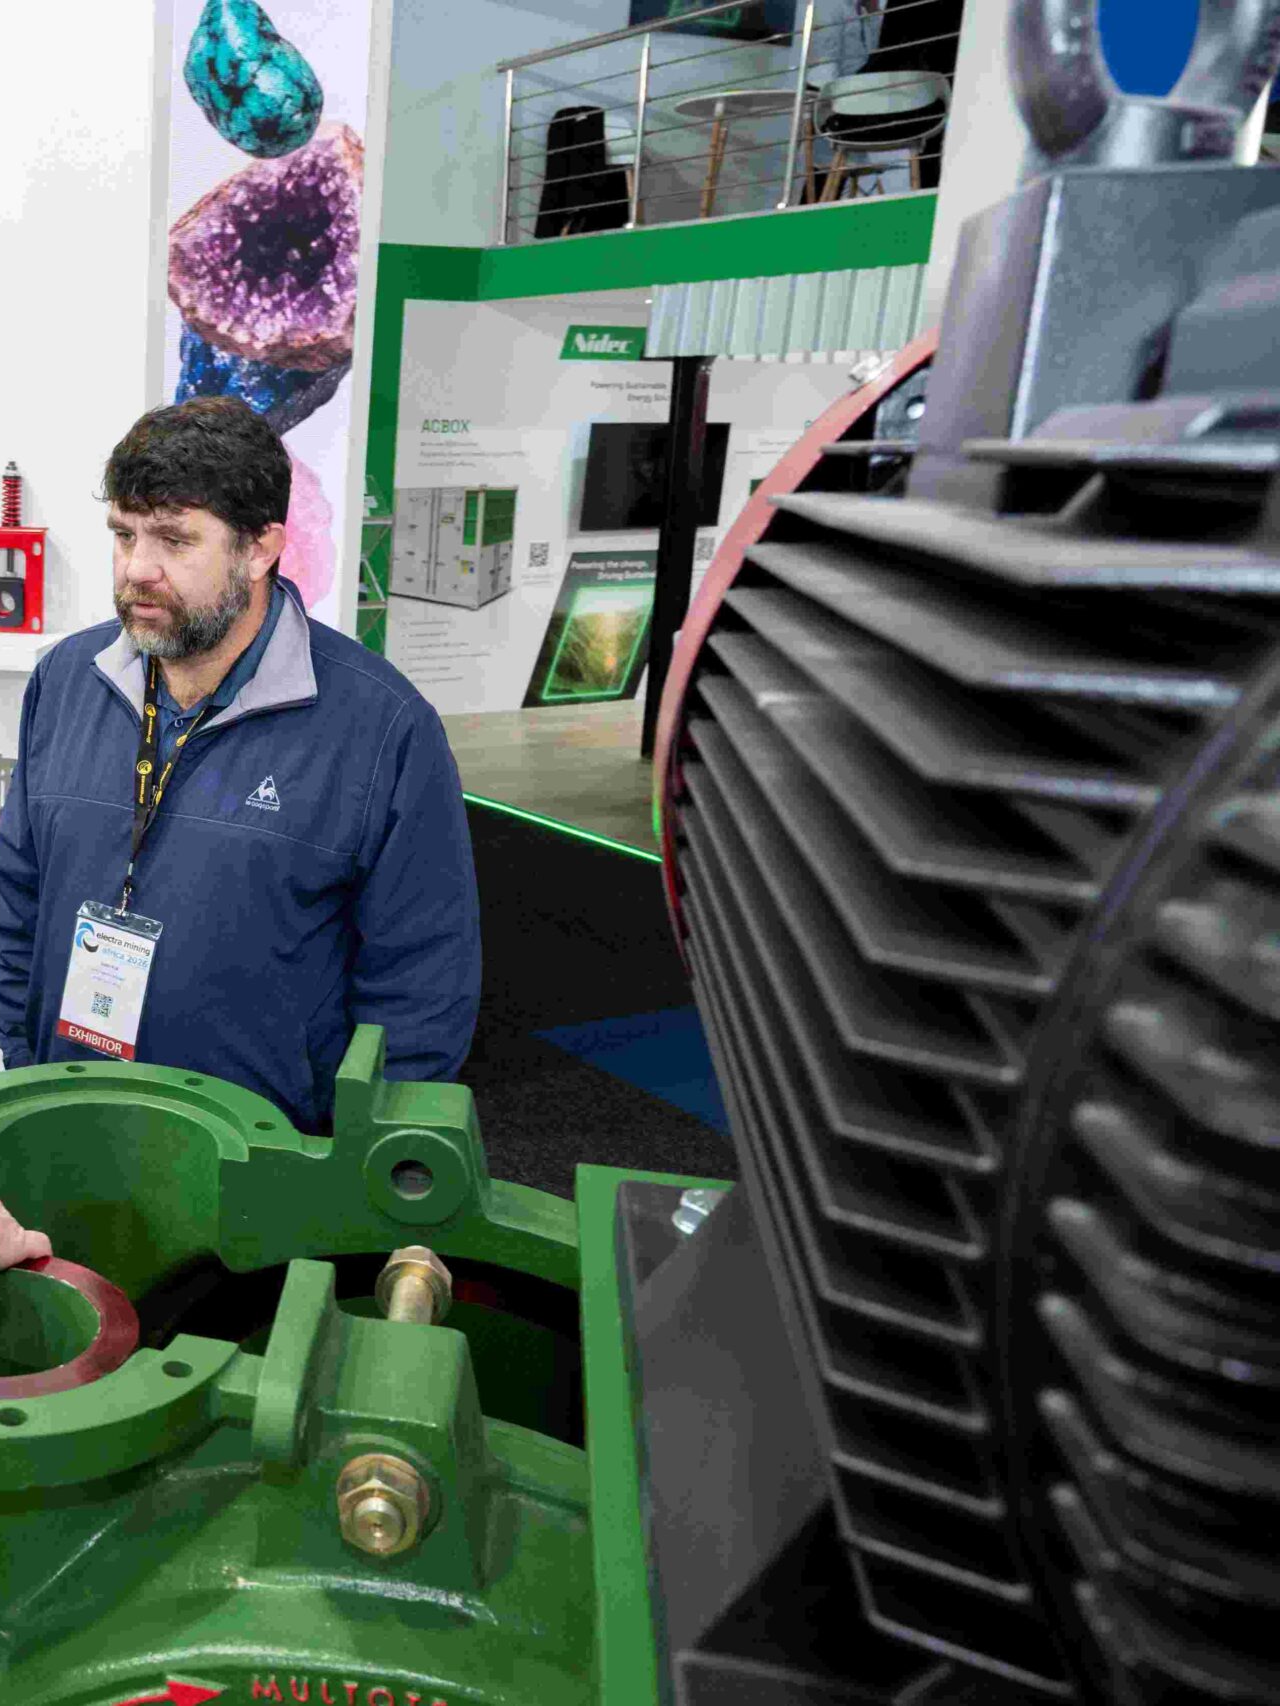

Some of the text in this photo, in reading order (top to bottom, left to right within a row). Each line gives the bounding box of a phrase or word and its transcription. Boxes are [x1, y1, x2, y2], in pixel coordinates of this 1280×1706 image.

[571, 332, 634, 354] Nidec
[606, 560, 618, 568] the
[96, 931, 151, 956] electra mining
[68, 1025, 123, 1054] EXHIBITOR
